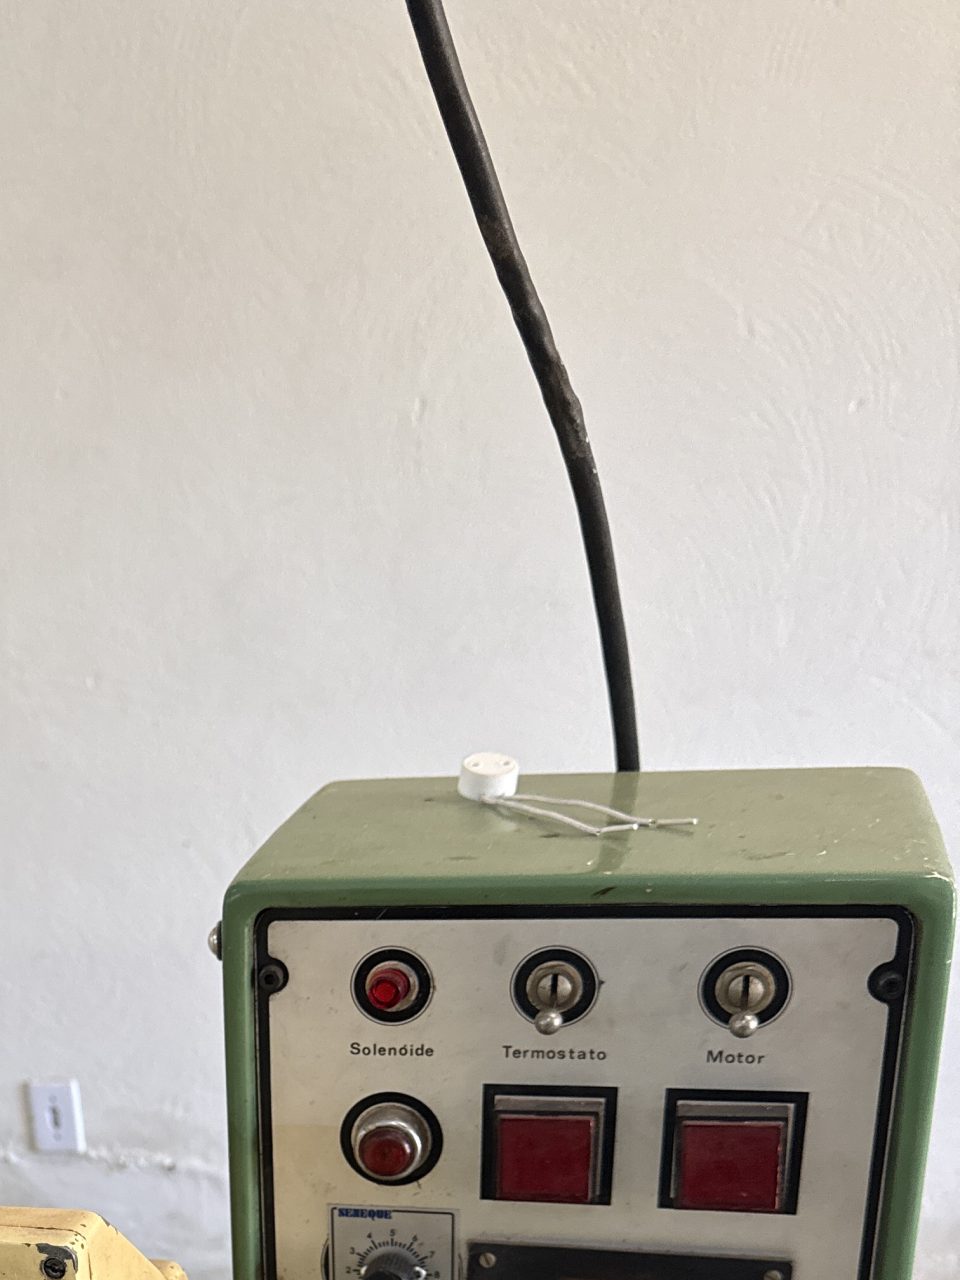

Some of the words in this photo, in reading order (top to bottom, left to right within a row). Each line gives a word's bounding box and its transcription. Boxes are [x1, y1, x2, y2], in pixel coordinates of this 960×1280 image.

[349, 1042, 435, 1058] Solenóide
[502, 1045, 608, 1061] Termostato
[705, 1049, 766, 1065] Motor
[390, 1229, 396, 1238] 5
